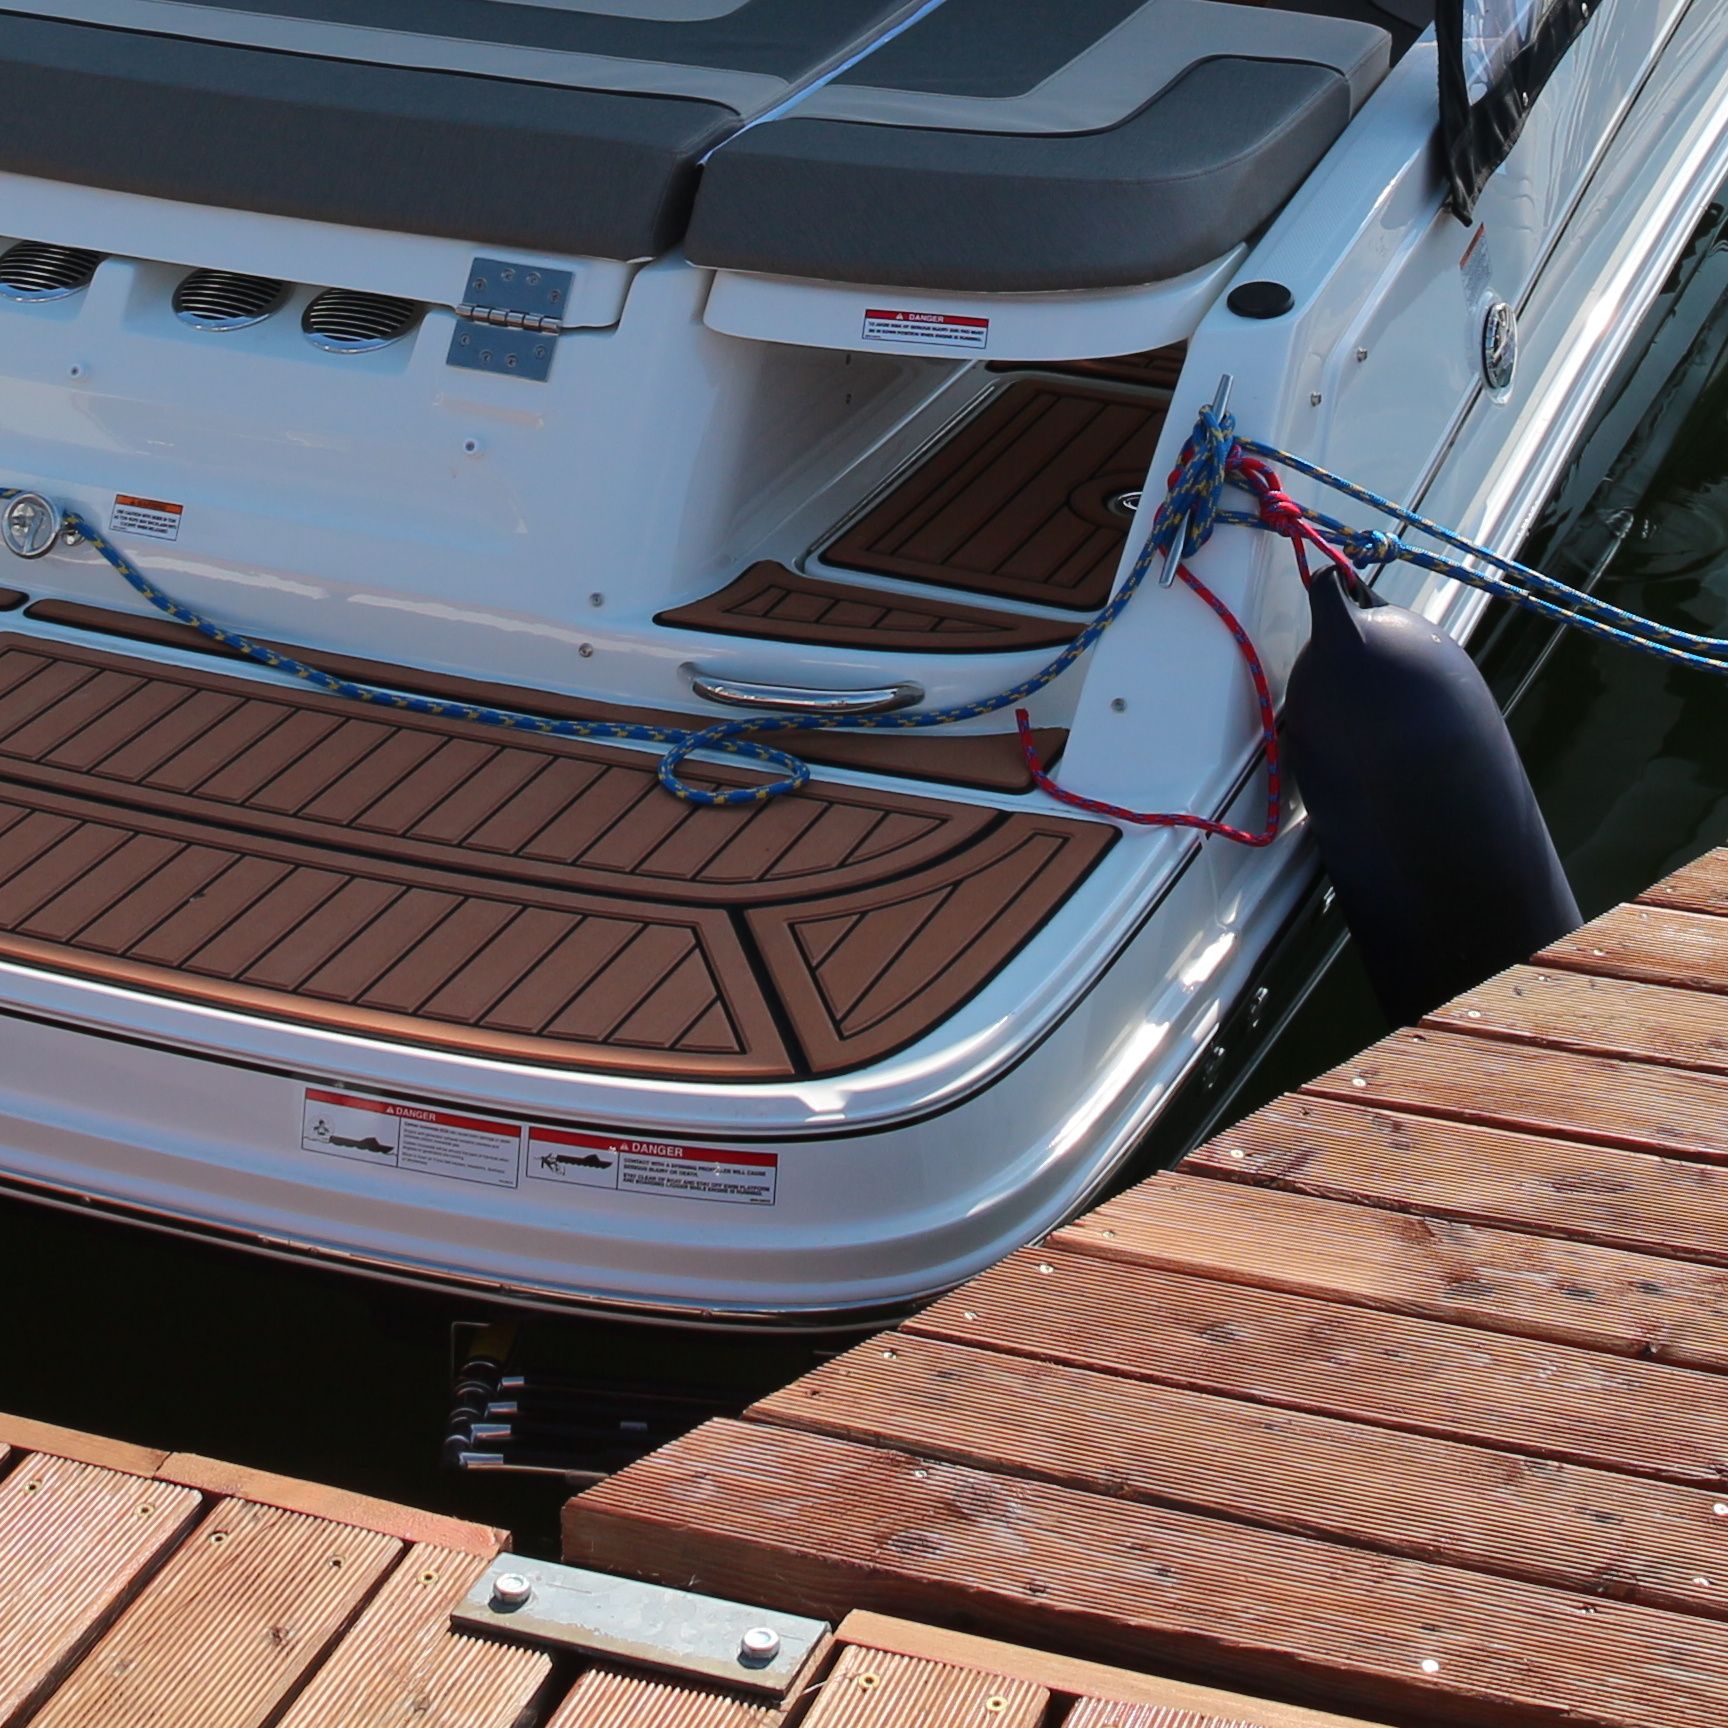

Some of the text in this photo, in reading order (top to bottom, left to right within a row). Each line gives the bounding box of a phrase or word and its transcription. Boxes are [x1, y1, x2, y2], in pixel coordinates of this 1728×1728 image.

[909, 314, 945, 323] DANGER
[396, 1107, 437, 1122] DANGER
[632, 1142, 683, 1157] DANGER
